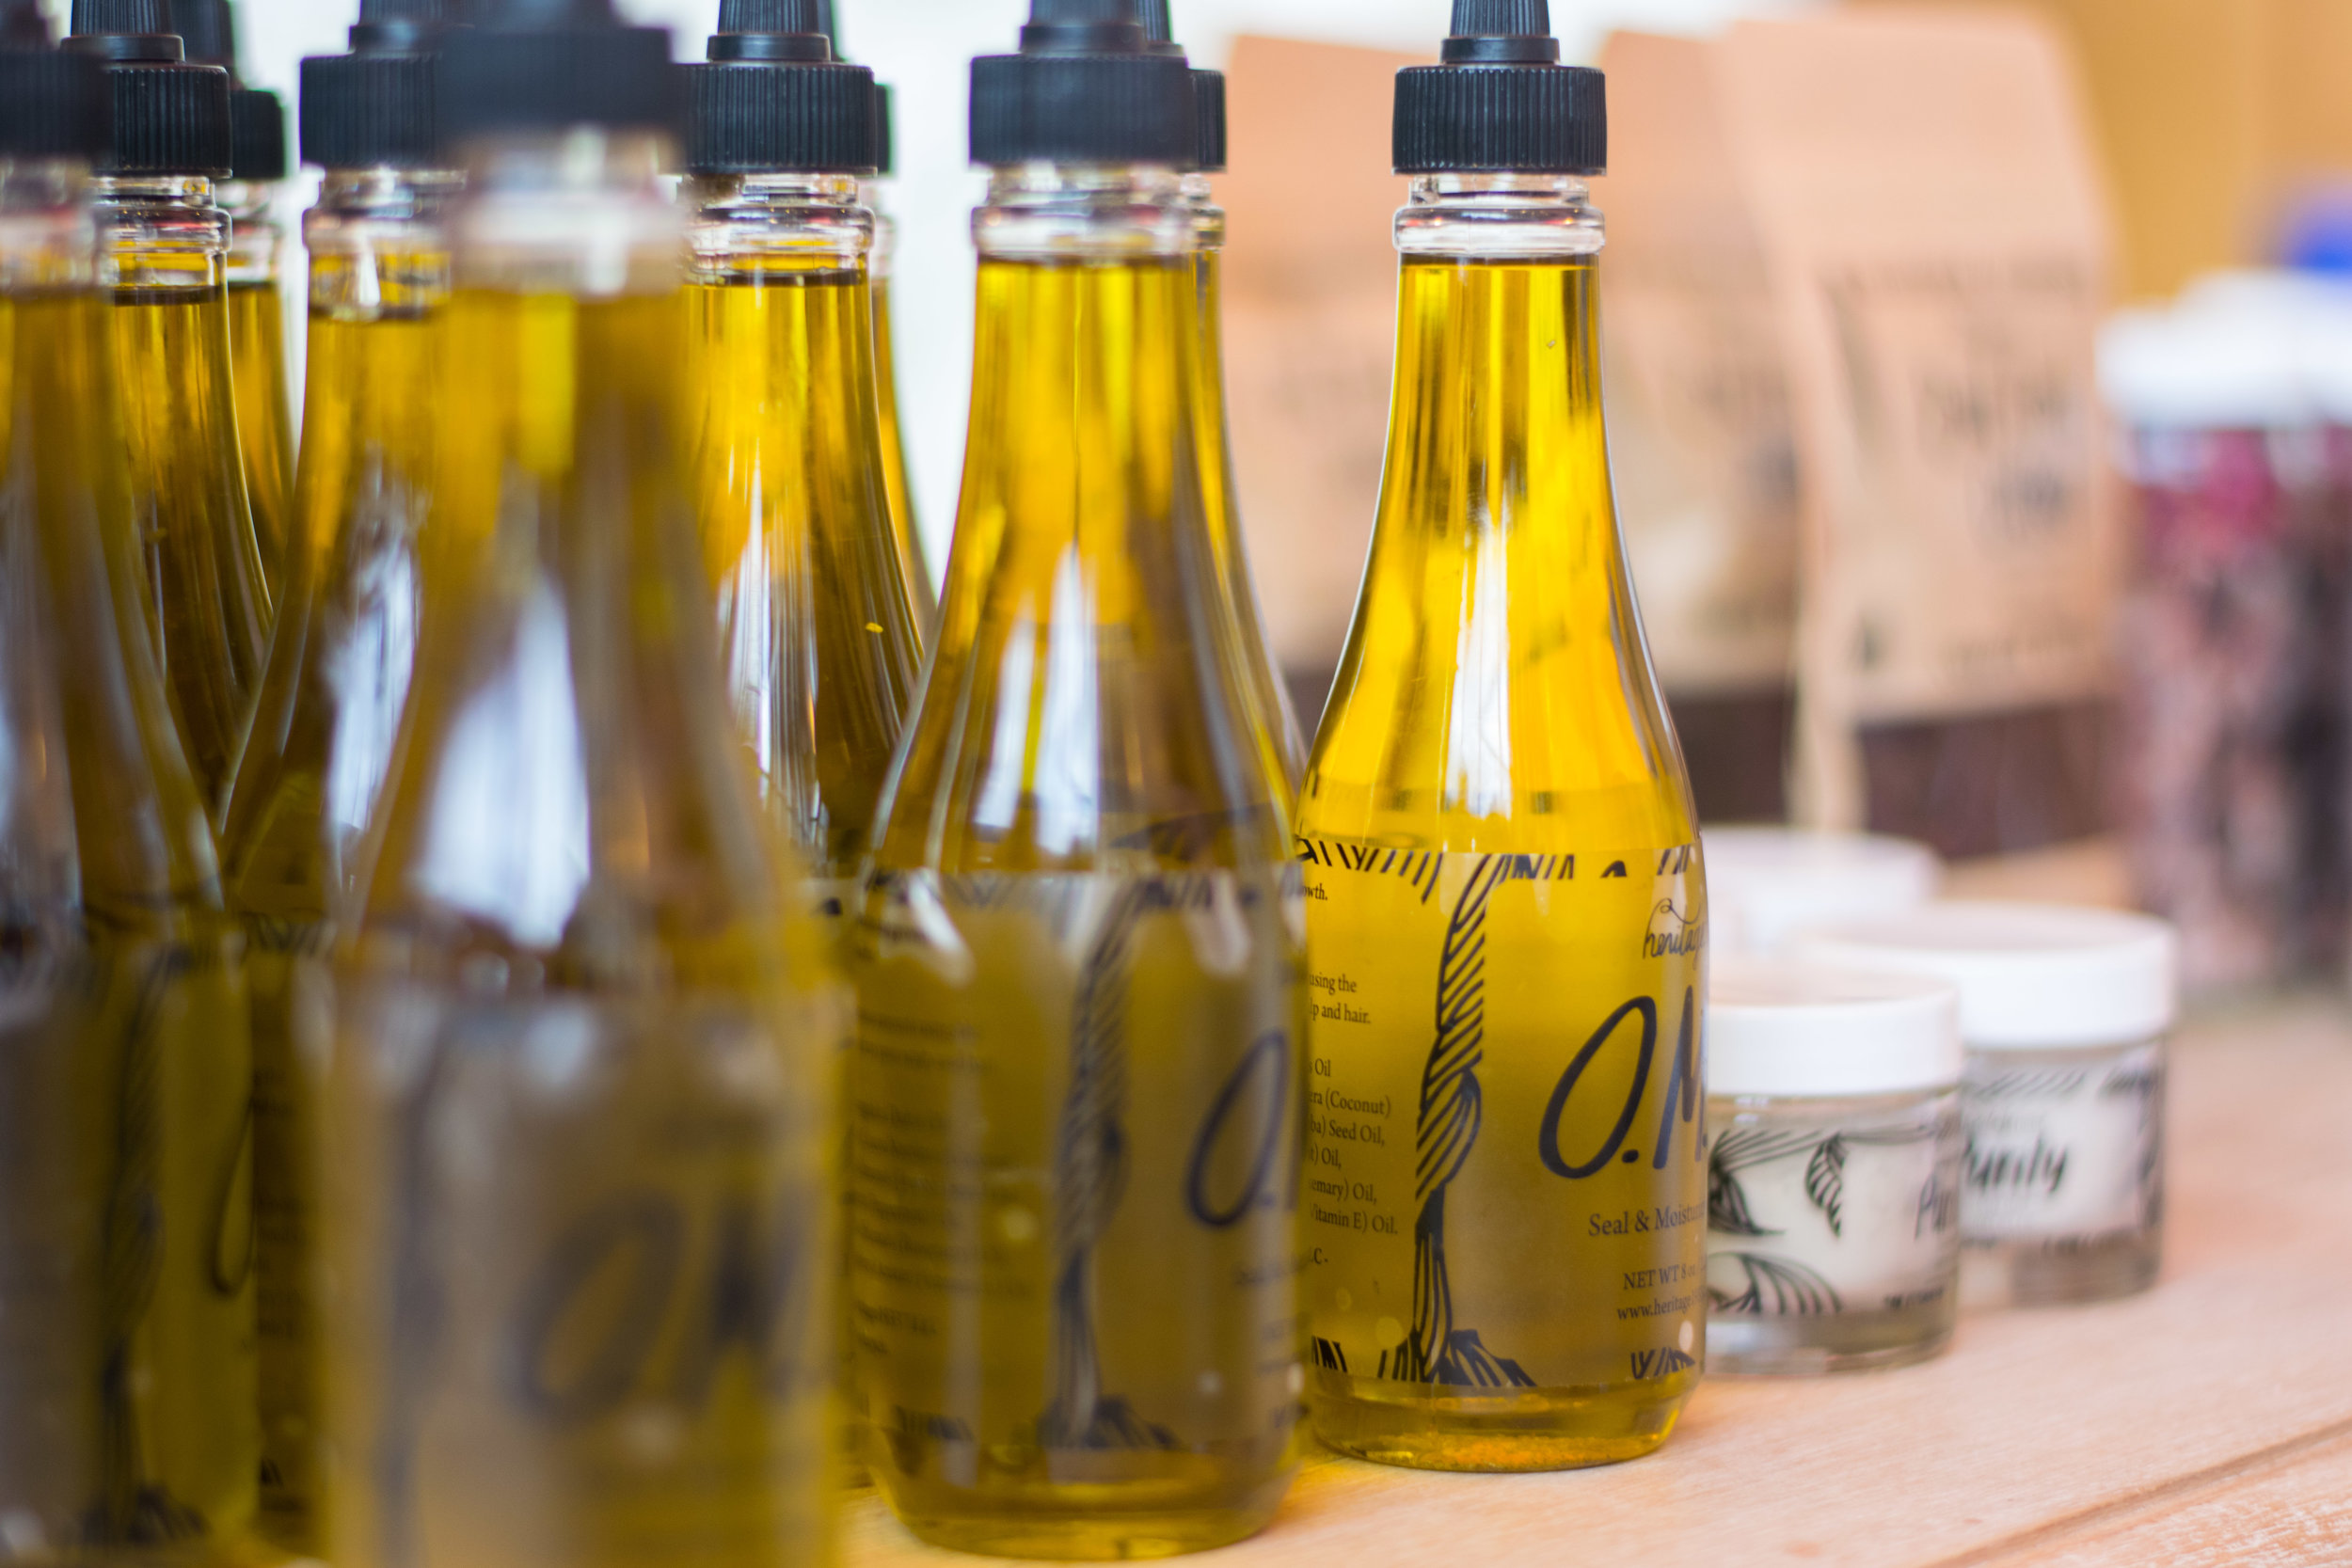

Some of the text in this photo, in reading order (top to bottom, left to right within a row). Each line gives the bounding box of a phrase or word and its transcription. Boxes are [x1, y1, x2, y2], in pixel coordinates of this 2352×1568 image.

[1303, 882, 1327, 901] owth.
[1310, 972, 1358, 995] using the
[1322, 1002, 1341, 1021] and
[1343, 1003, 1371, 1024] hair.
[1314, 1057, 1331, 1078] Oil
[1325, 1087, 1391, 1120] (Coconut)
[1328, 1119, 1357, 1141] Seed
[1359, 1124, 1385, 1148] Oil,
[1321, 1147, 1342, 1170] Oil,
[1311, 1177, 1377, 1205] emary) Oil,
[1353, 1211, 1368, 1234] E)
[1371, 1214, 1399, 1235] Oil.
[1588, 1211, 1629, 1237] Seal
[1634, 1209, 1650, 1232] &
[1623, 1268, 1656, 1291] NET
[1659, 1263, 1679, 1284] WT
